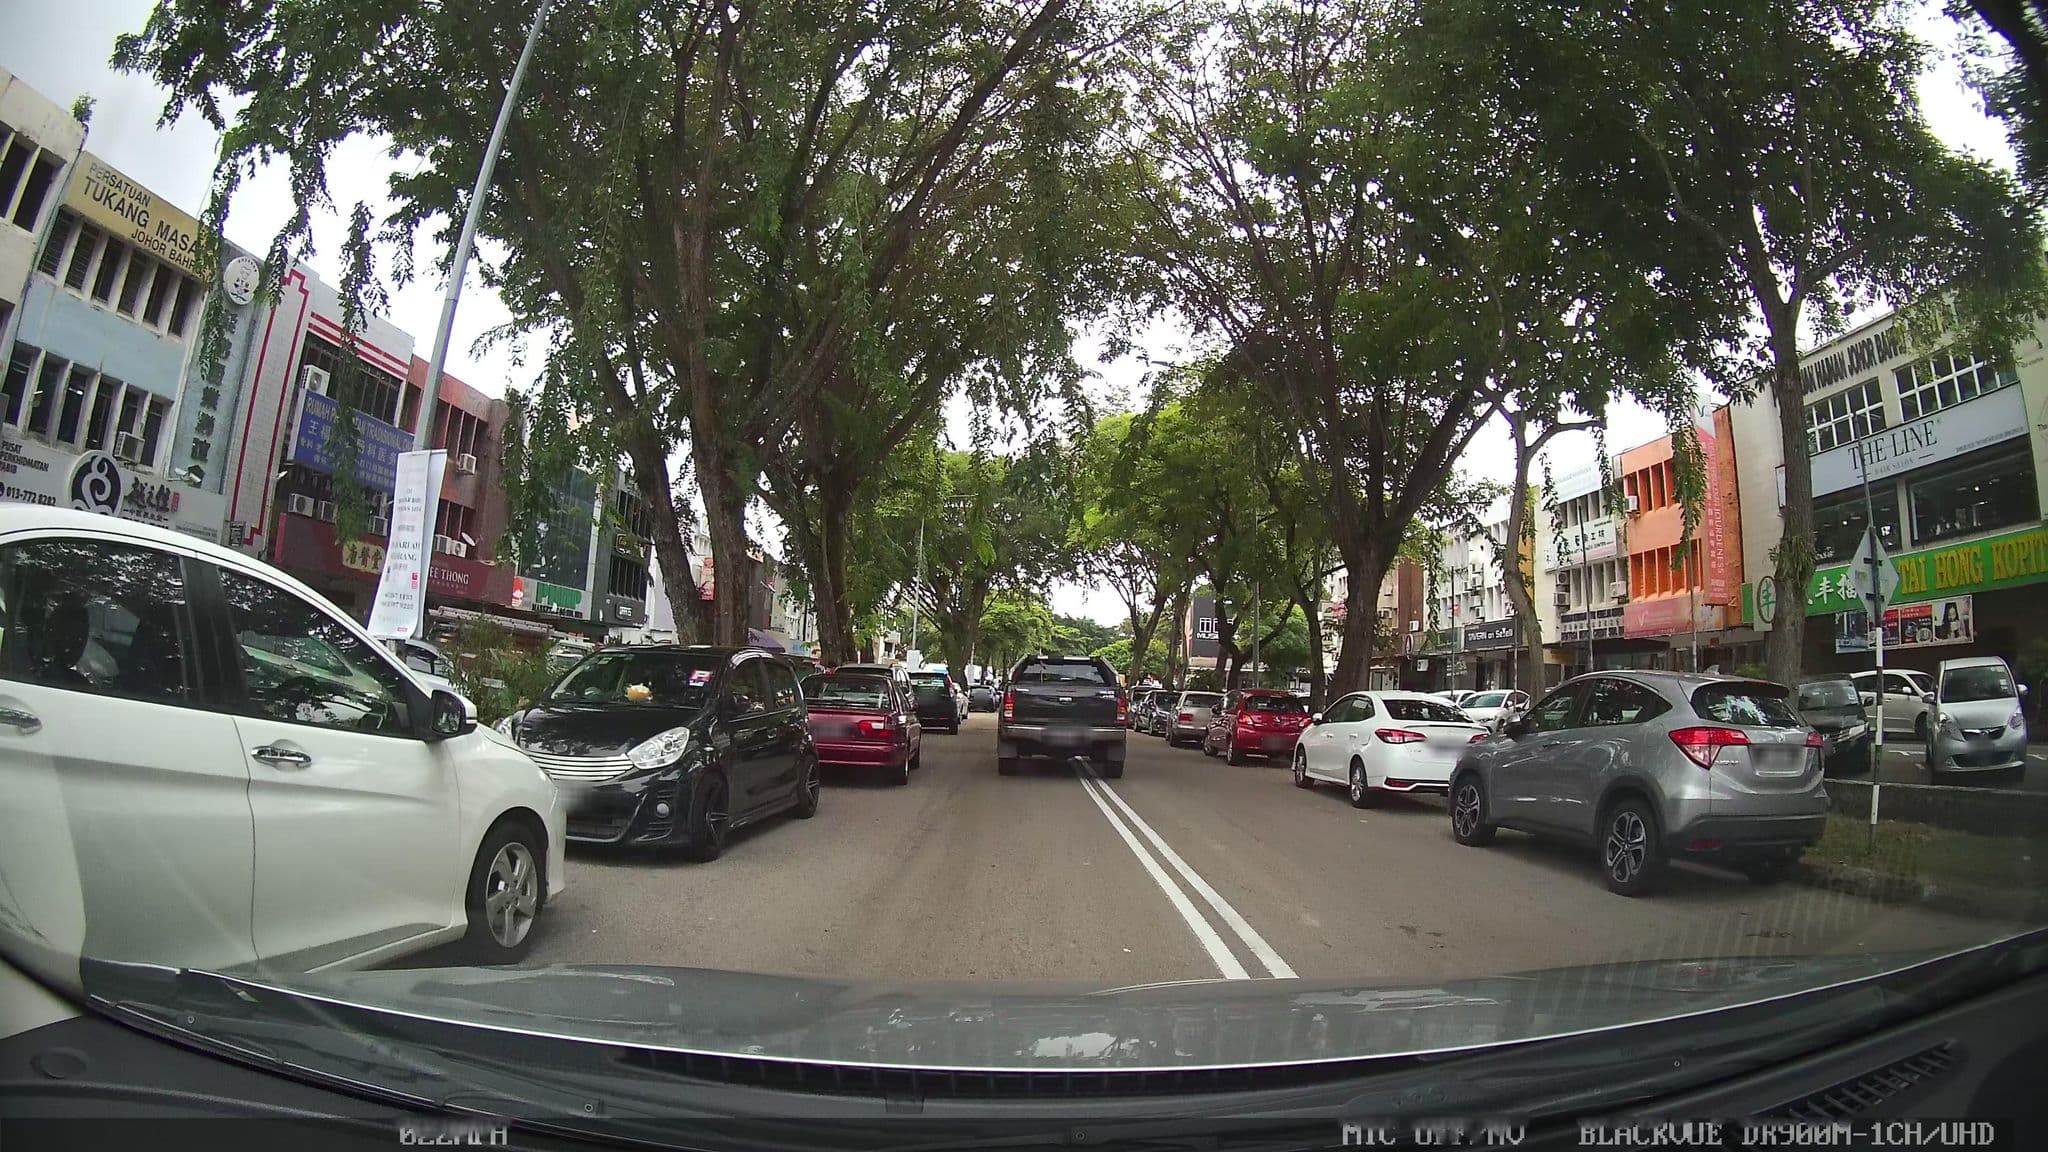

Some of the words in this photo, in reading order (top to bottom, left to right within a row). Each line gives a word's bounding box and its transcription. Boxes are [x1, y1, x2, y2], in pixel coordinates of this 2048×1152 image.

[89, 163, 151, 208] PERSATUAN
[82, 176, 150, 227] TUKANG
[155, 220, 199, 254] MASA
[131, 228, 166, 255] JOHOR
[169, 249, 200, 272] BAHR
[1847, 338, 1878, 378] JOHOR
[1, 440, 23, 453] PUSAT
[1848, 436, 1886, 469] THE
[1892, 420, 1938, 455] LINE
[6, 486, 38, 502] 013-772
[430, 566, 438, 579] EE
[441, 569, 470, 585] THONG
[1899, 556, 1928, 594] TAI
[1934, 544, 1983, 590] HONG
